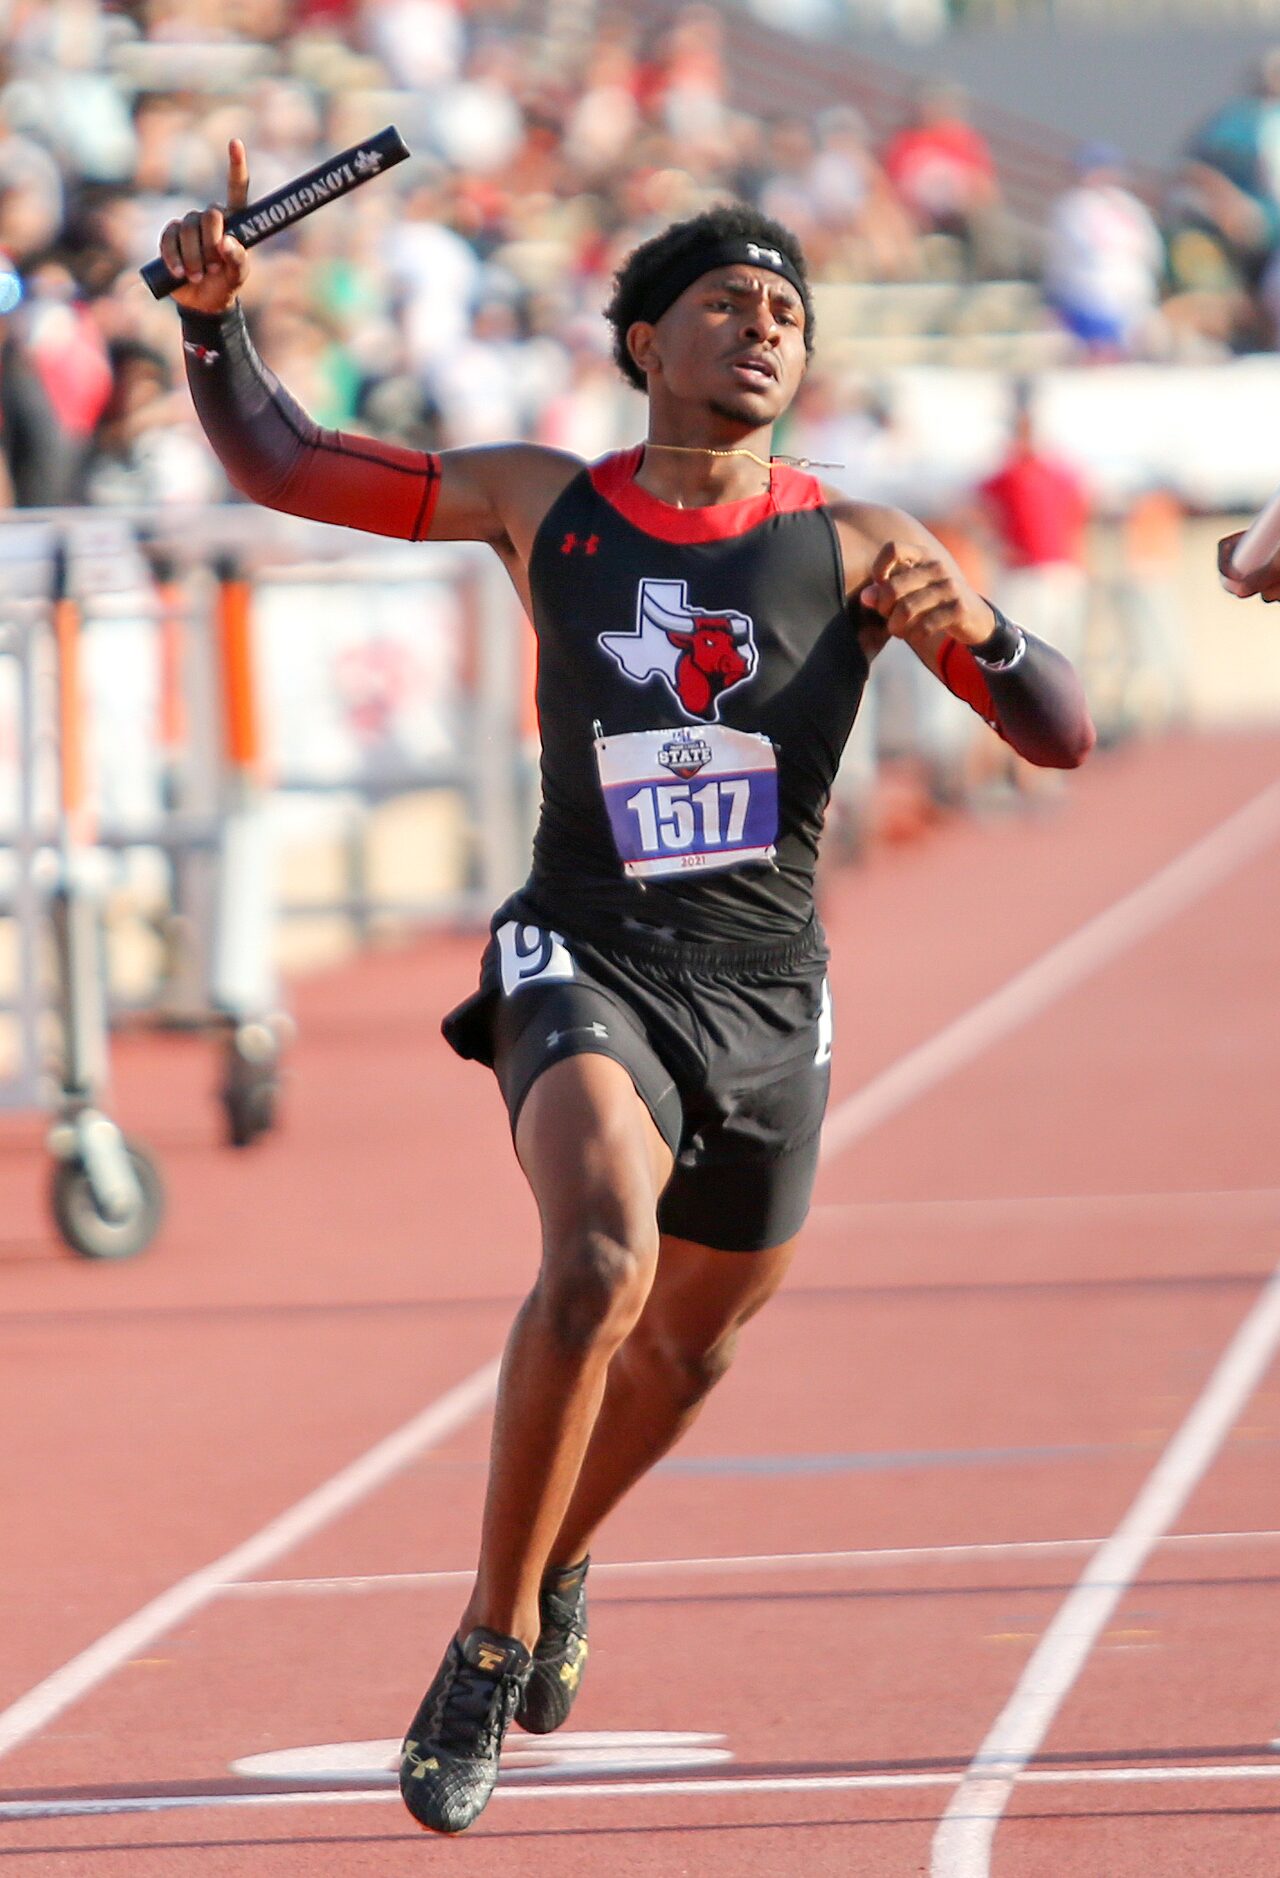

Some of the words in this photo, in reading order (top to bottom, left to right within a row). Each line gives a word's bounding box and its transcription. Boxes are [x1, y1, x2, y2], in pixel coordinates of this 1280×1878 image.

[239, 163, 357, 241] LONGHORN
[658, 748, 712, 764] STATE
[626, 779, 750, 851] 1517
[680, 856, 707, 867] 2021
[514, 921, 553, 979] 9
